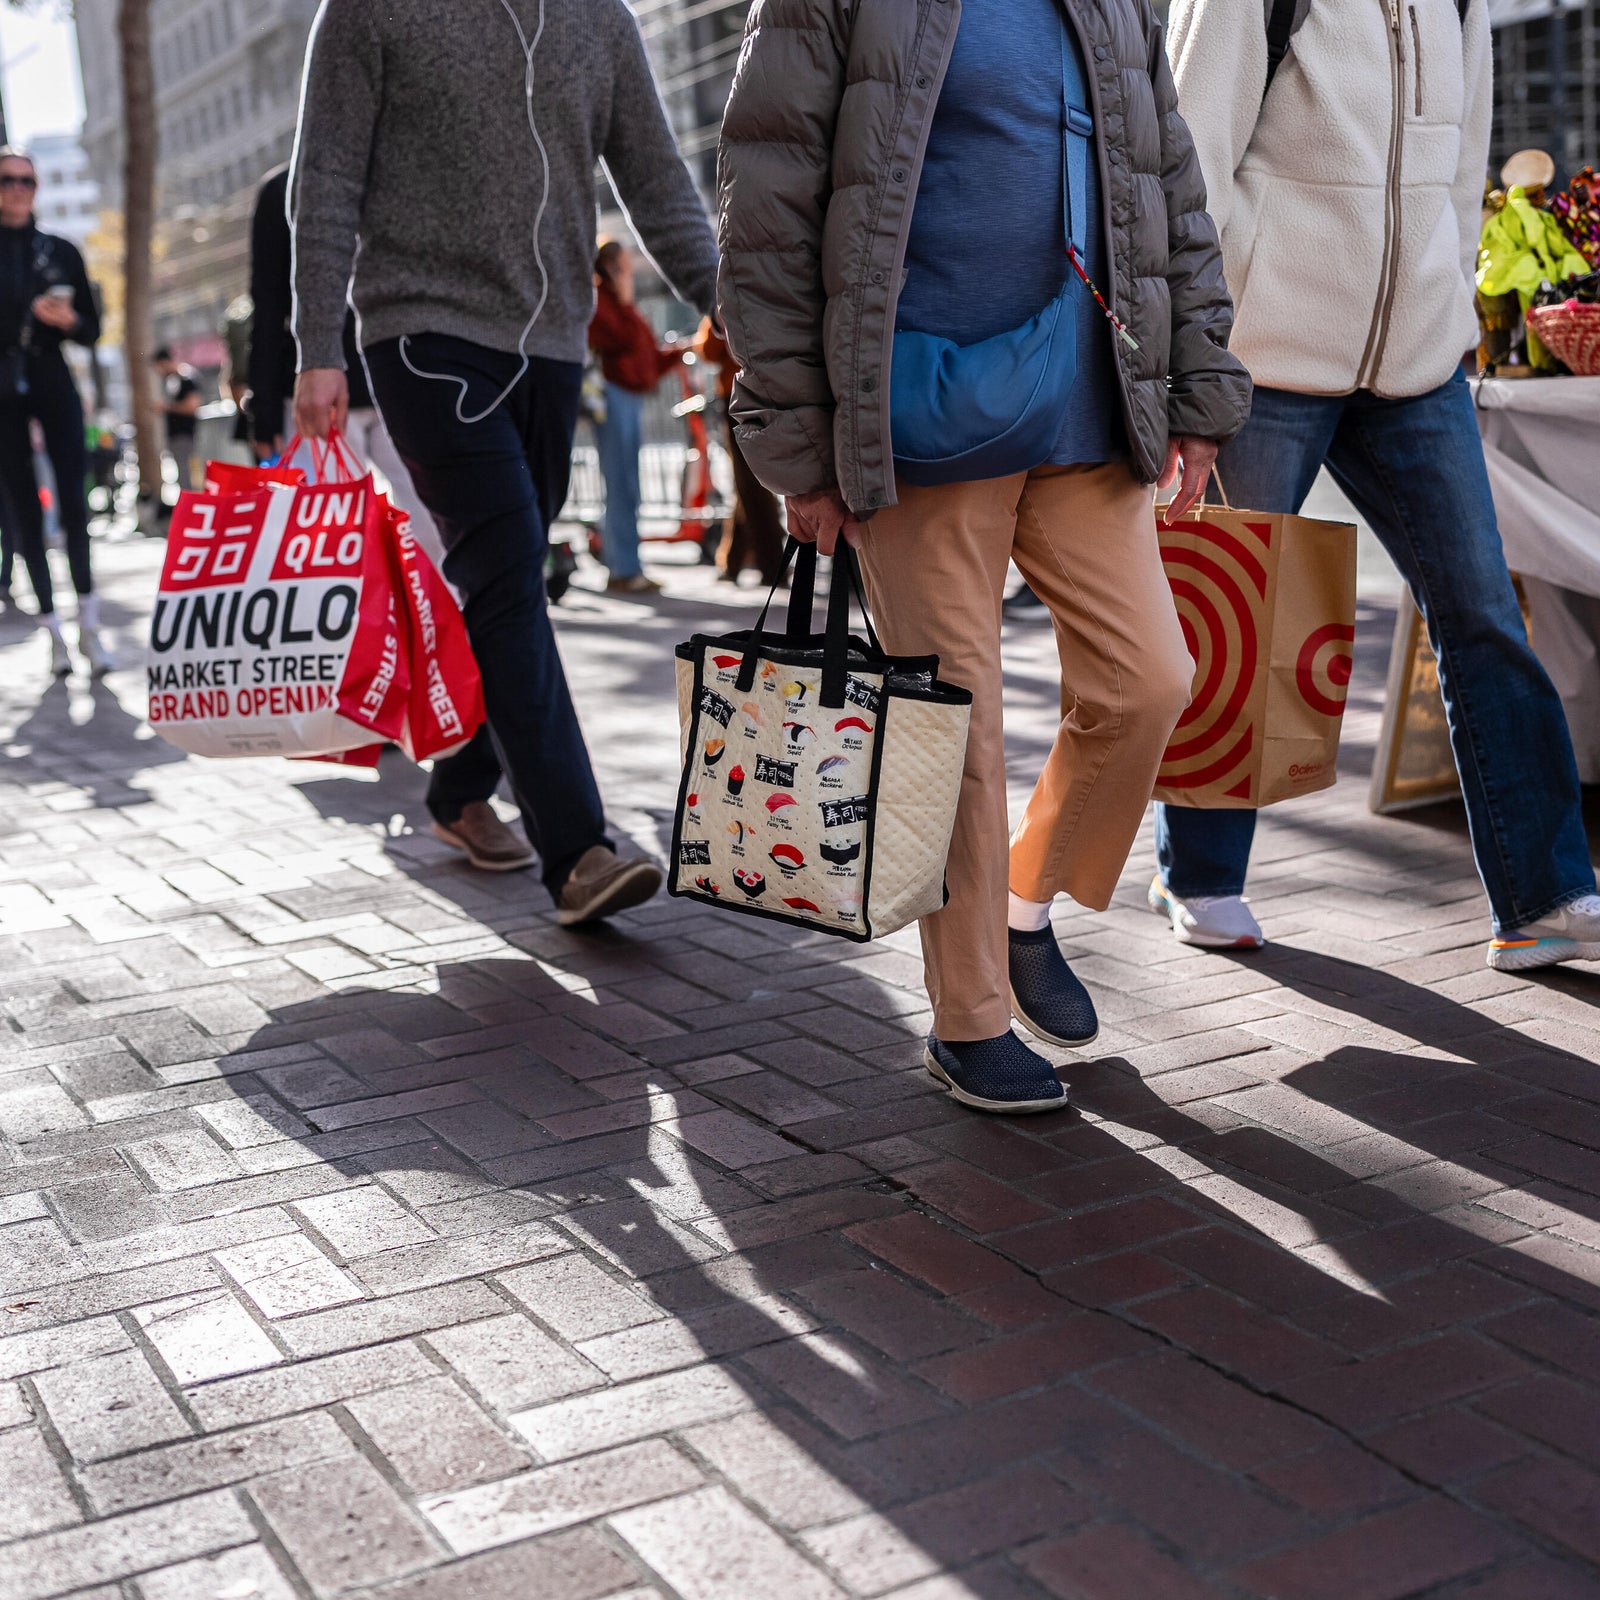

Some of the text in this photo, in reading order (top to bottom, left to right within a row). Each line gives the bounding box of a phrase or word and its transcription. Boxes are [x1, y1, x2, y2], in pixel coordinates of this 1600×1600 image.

[296, 489, 365, 528] UNI
[284, 531, 363, 574] QLO
[151, 584, 358, 653] UNIQLO
[408, 569, 437, 655] MARKET
[426, 658, 464, 739] STREET
[148, 659, 242, 690] MARKET
[359, 633, 398, 724] STREET
[149, 685, 334, 722] GRAND OPENIN
[842, 743, 862, 751] Octopus
[756, 760, 777, 784] 寿司
[826, 805, 855, 826] 寿司
